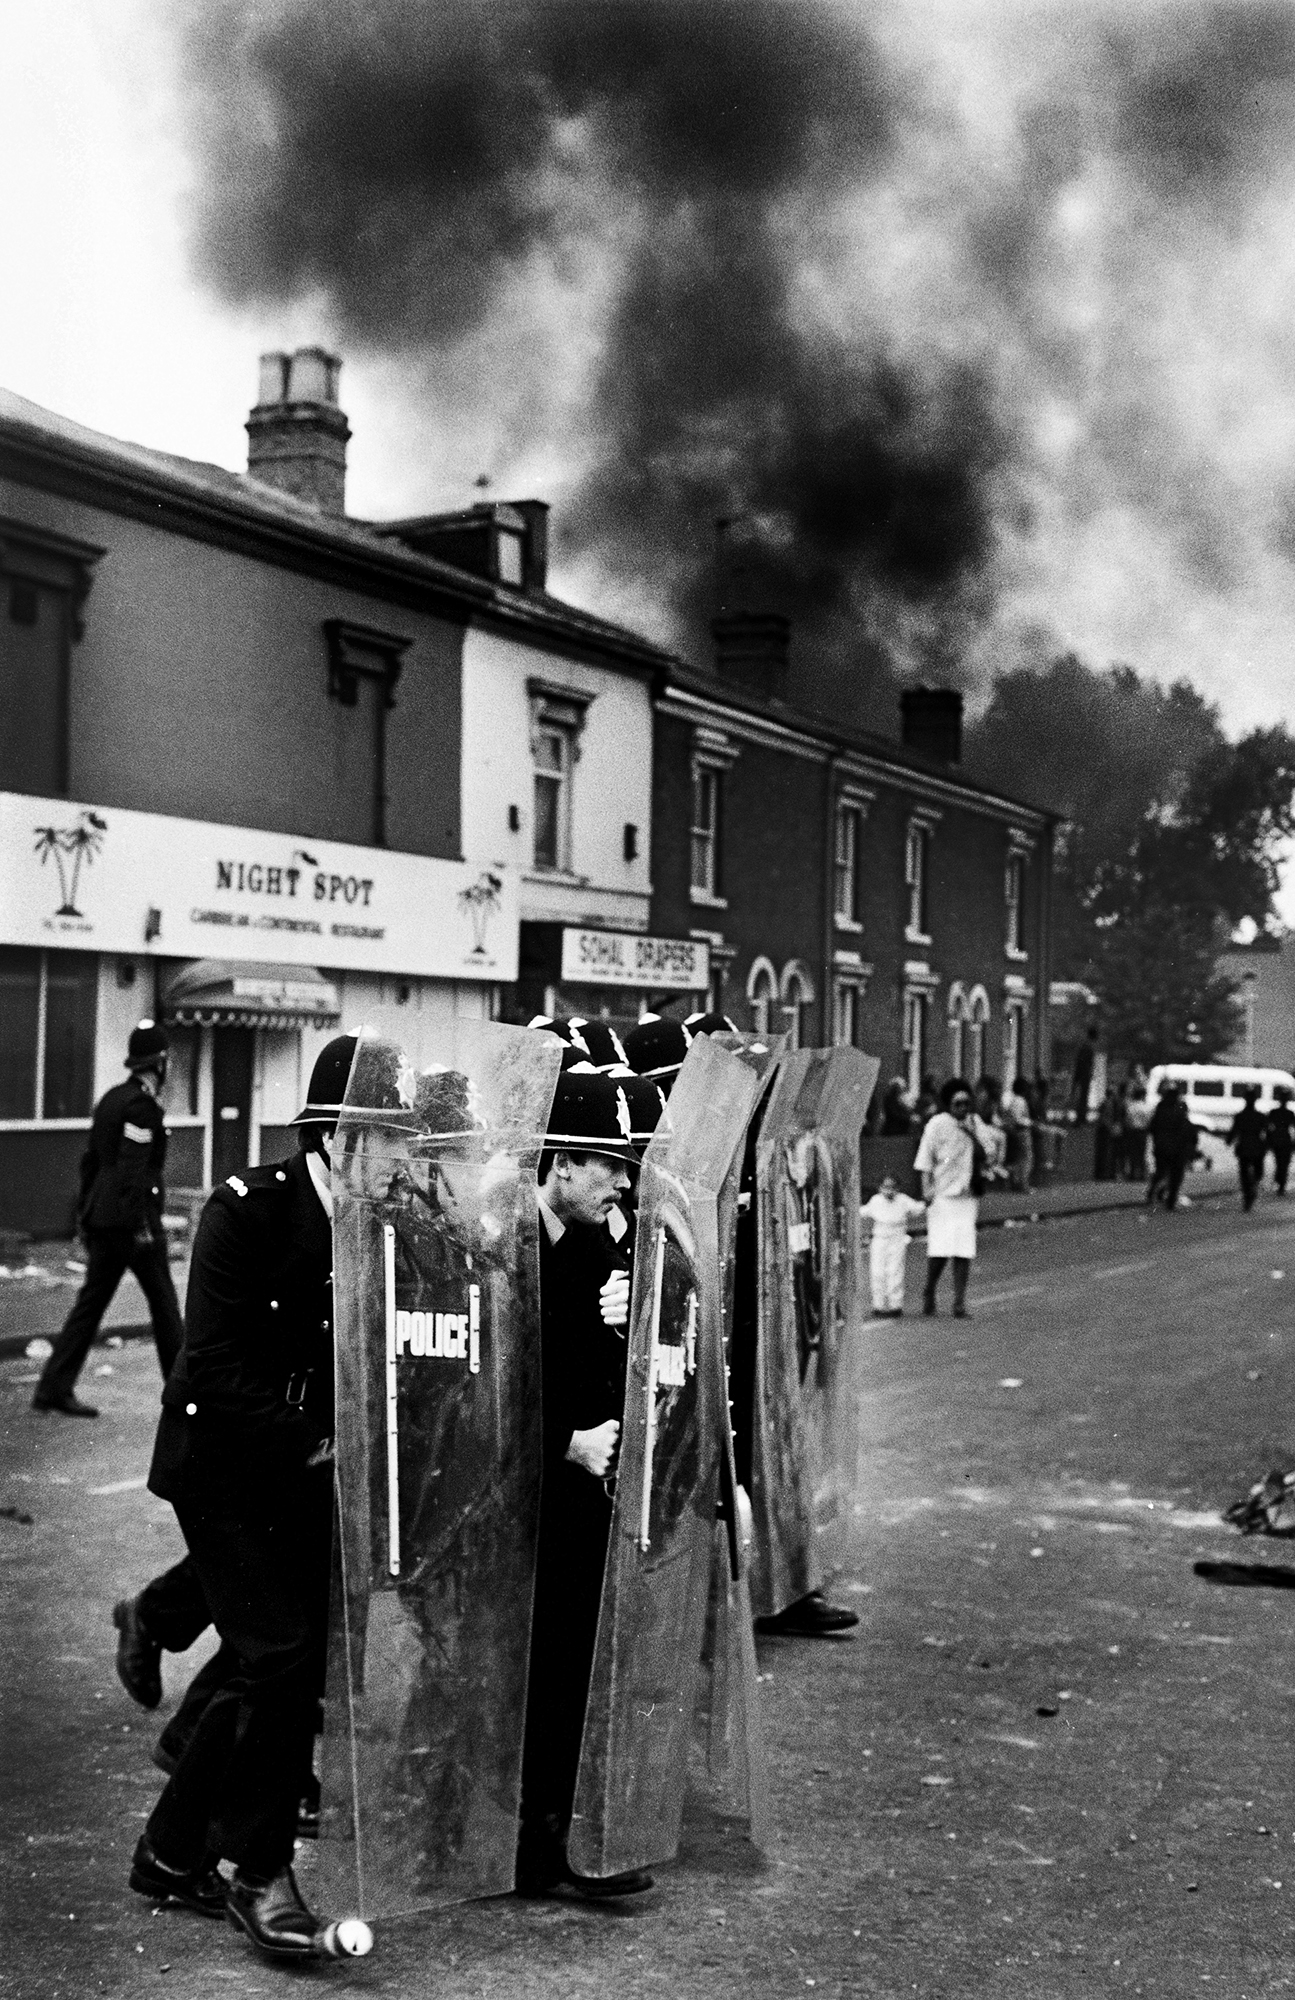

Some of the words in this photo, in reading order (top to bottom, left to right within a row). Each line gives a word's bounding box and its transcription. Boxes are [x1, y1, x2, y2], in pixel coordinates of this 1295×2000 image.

[216, 860, 300, 897] NIGHT
[313, 871, 374, 906] SPOT
[636, 941, 697, 973] DRAPERS
[396, 1309, 469, 1359] POLICE
